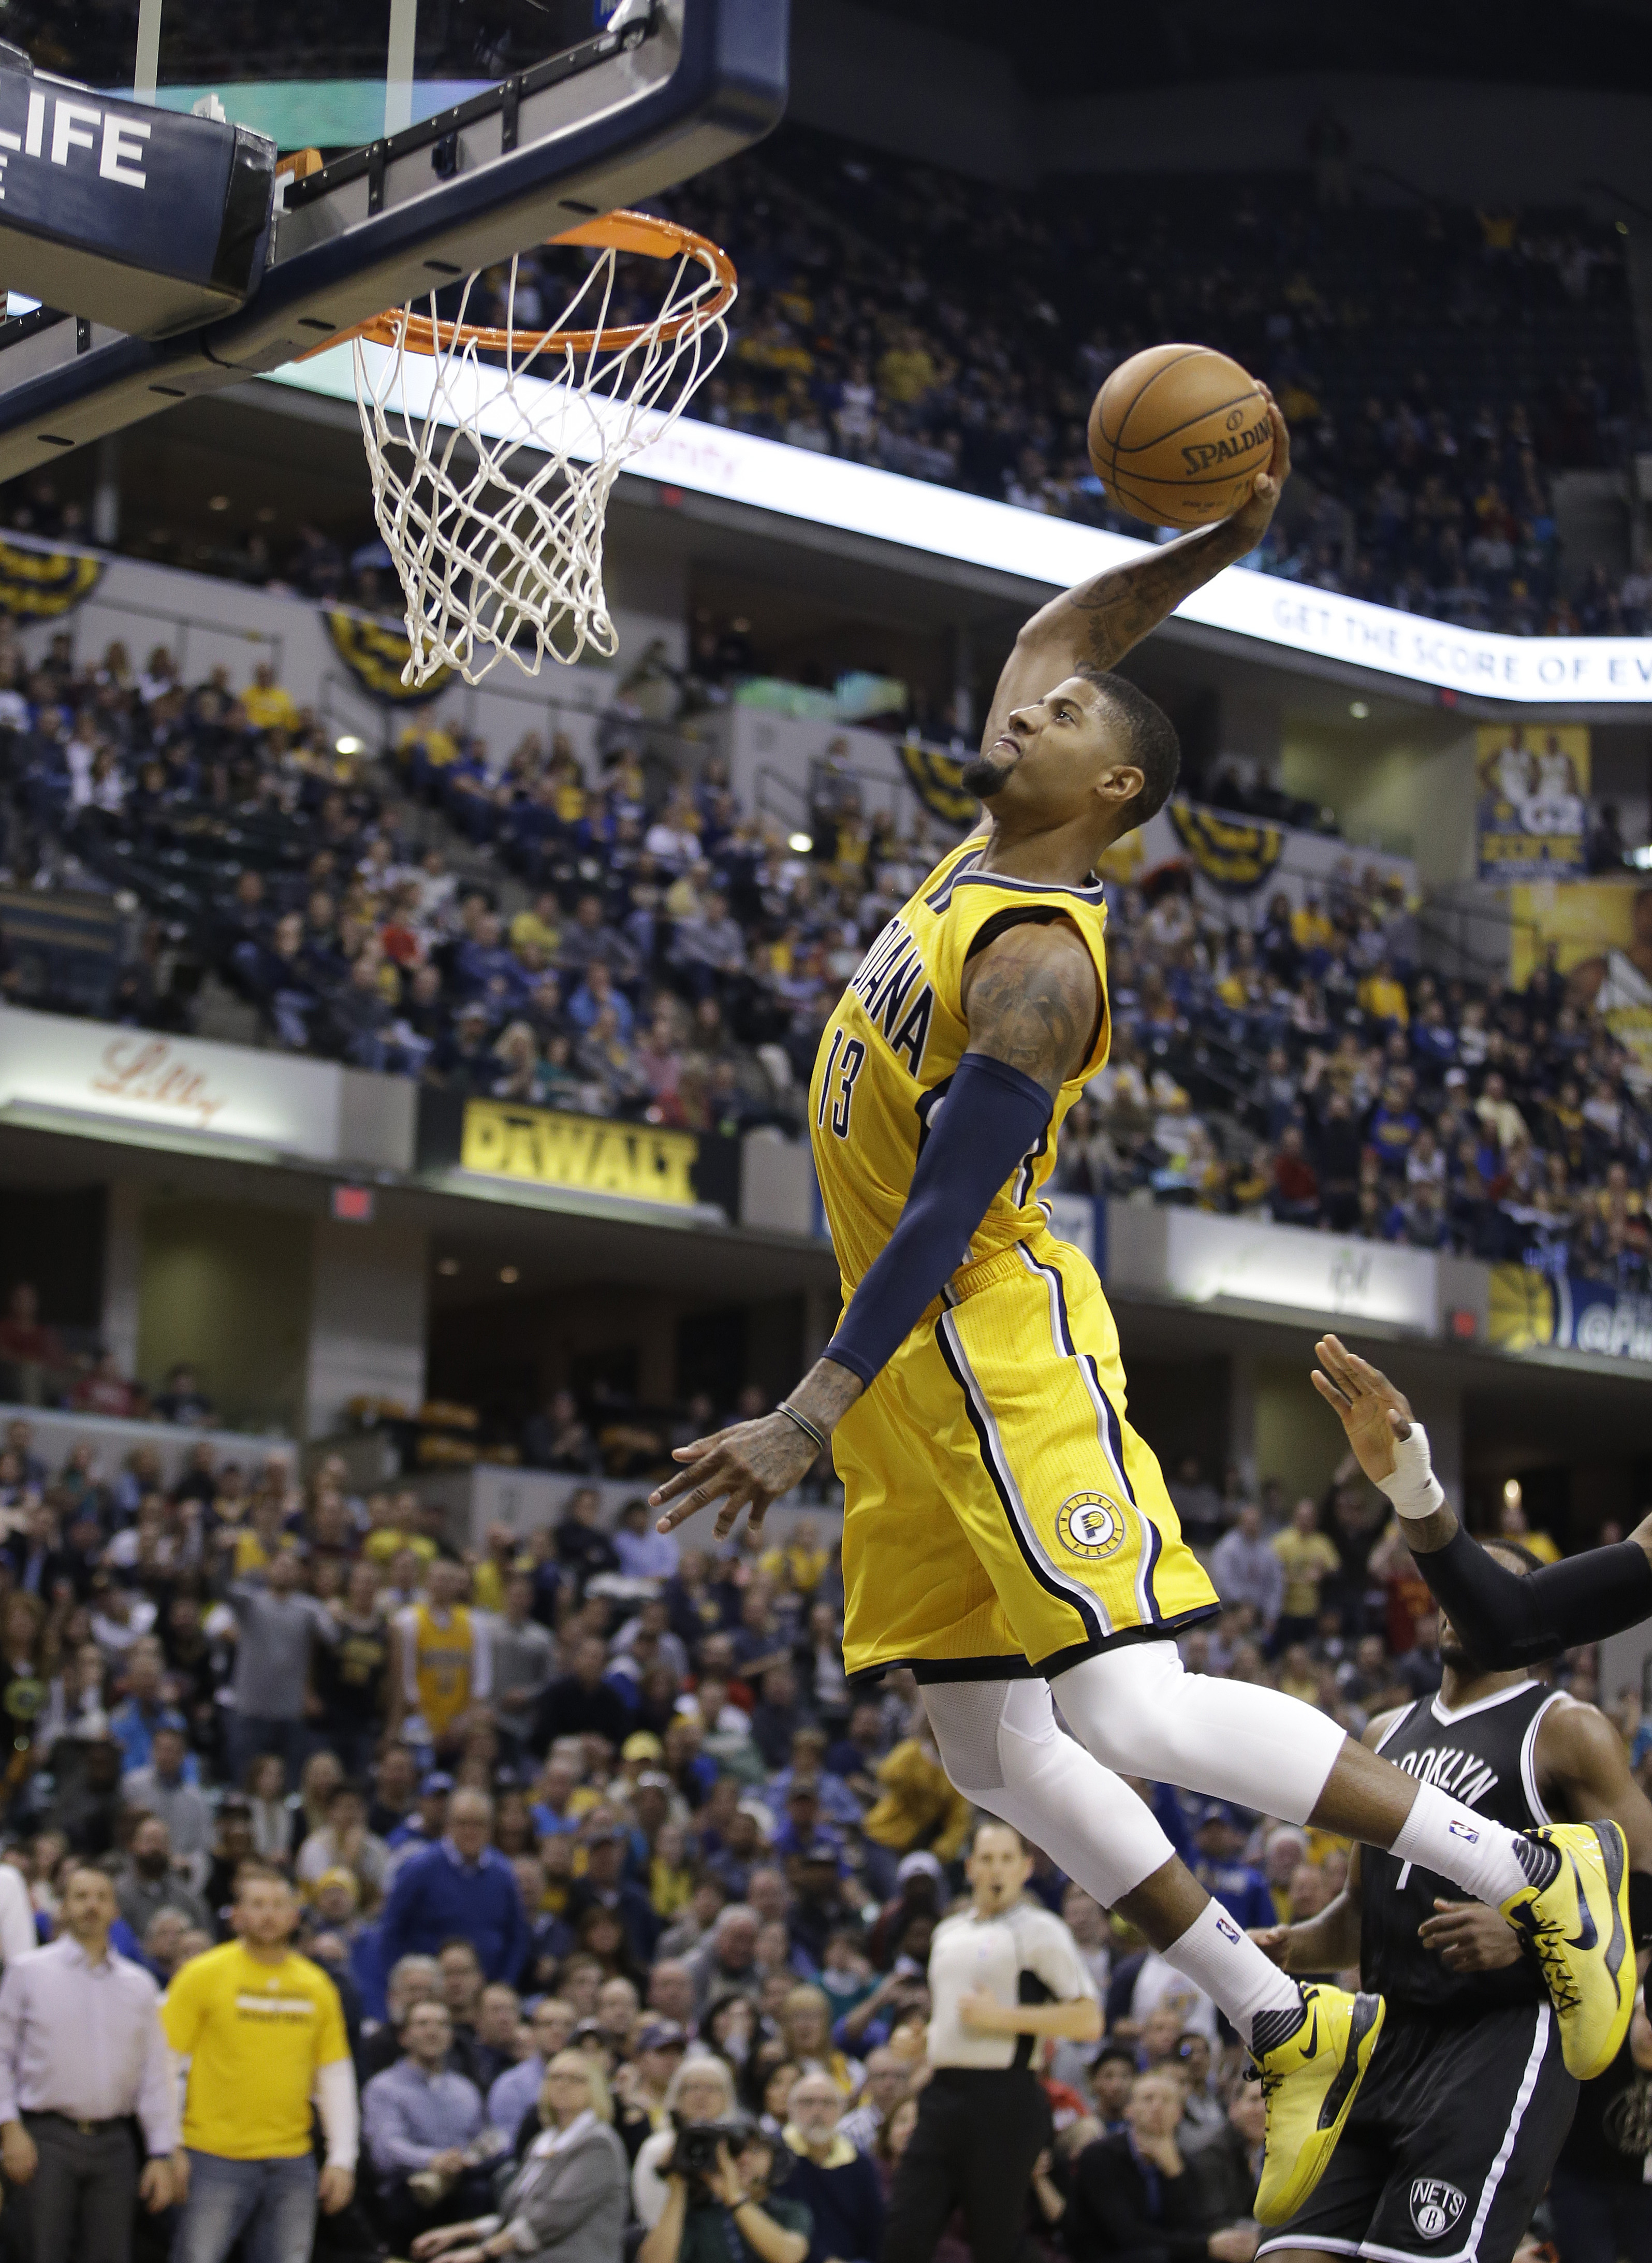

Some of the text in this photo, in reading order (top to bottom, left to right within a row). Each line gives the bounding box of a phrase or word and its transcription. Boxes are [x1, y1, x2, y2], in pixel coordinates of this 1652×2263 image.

[1181, 416, 1273, 475] SPALDIN
[1273, 597, 1331, 637] GET
[1344, 615, 1400, 660] THE
[1412, 632, 1521, 685] SCORE
[1537, 655, 1591, 686] OF
[818, 1026, 867, 1139] 13
[1059, 1494, 1113, 1533] INDIANA
[1072, 1527, 1123, 1556] PACERS
[1391, 1746, 1499, 1808] OOKLYN
[1412, 2181, 1463, 2217] NETS
[1425, 2209, 1438, 2229] B
